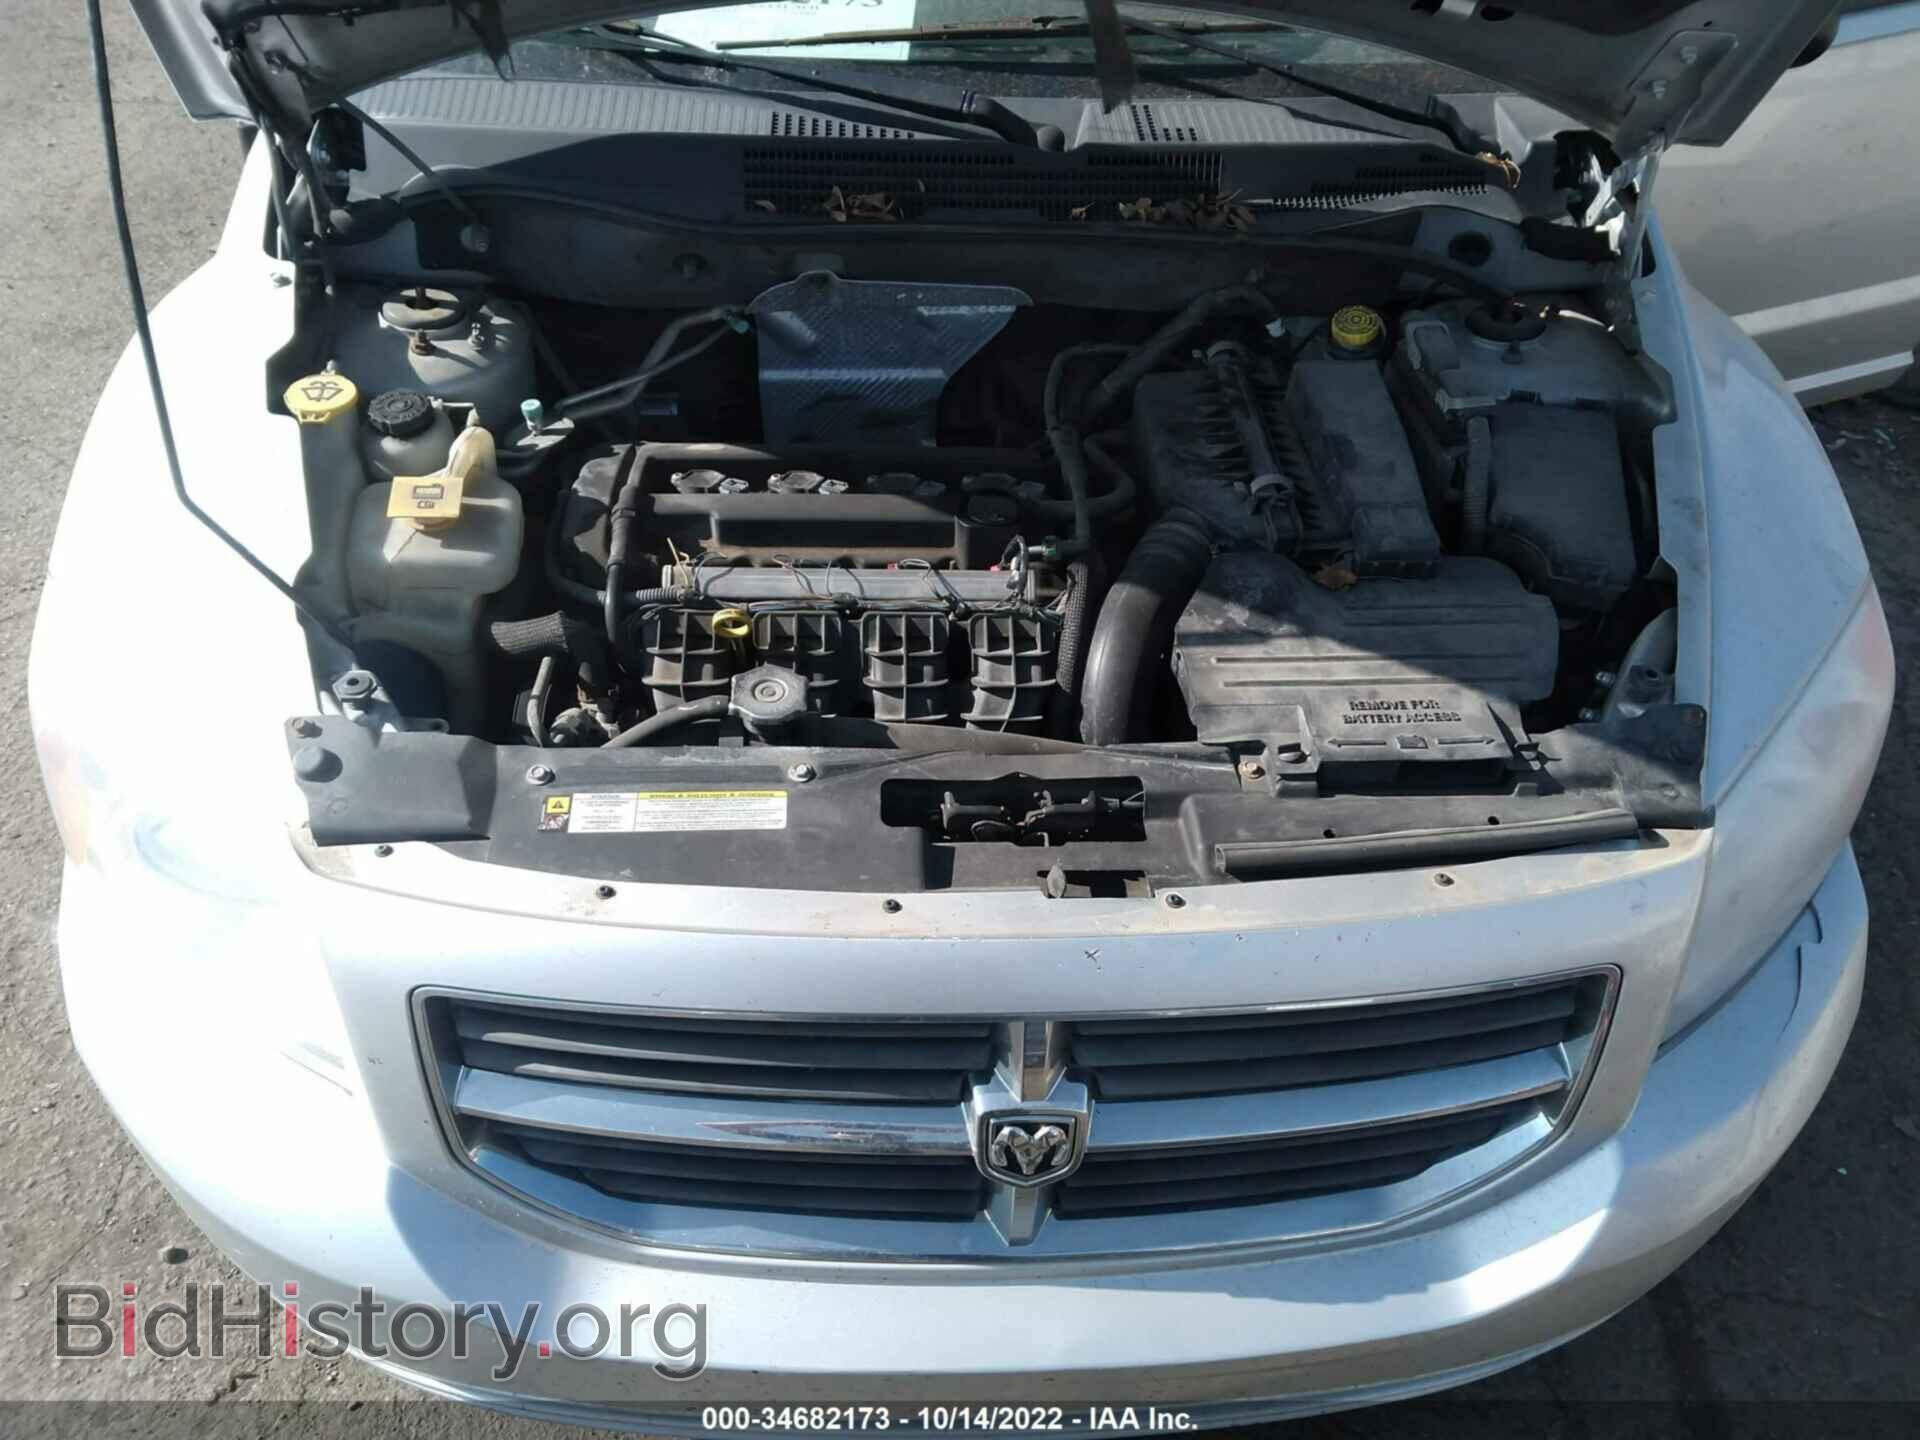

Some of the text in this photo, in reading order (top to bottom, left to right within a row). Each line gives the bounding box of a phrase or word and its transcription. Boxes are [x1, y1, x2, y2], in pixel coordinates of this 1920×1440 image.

[1349, 699, 1441, 711] REMOVE FOR
[1343, 712, 1462, 724] BATTERY ACCESS
